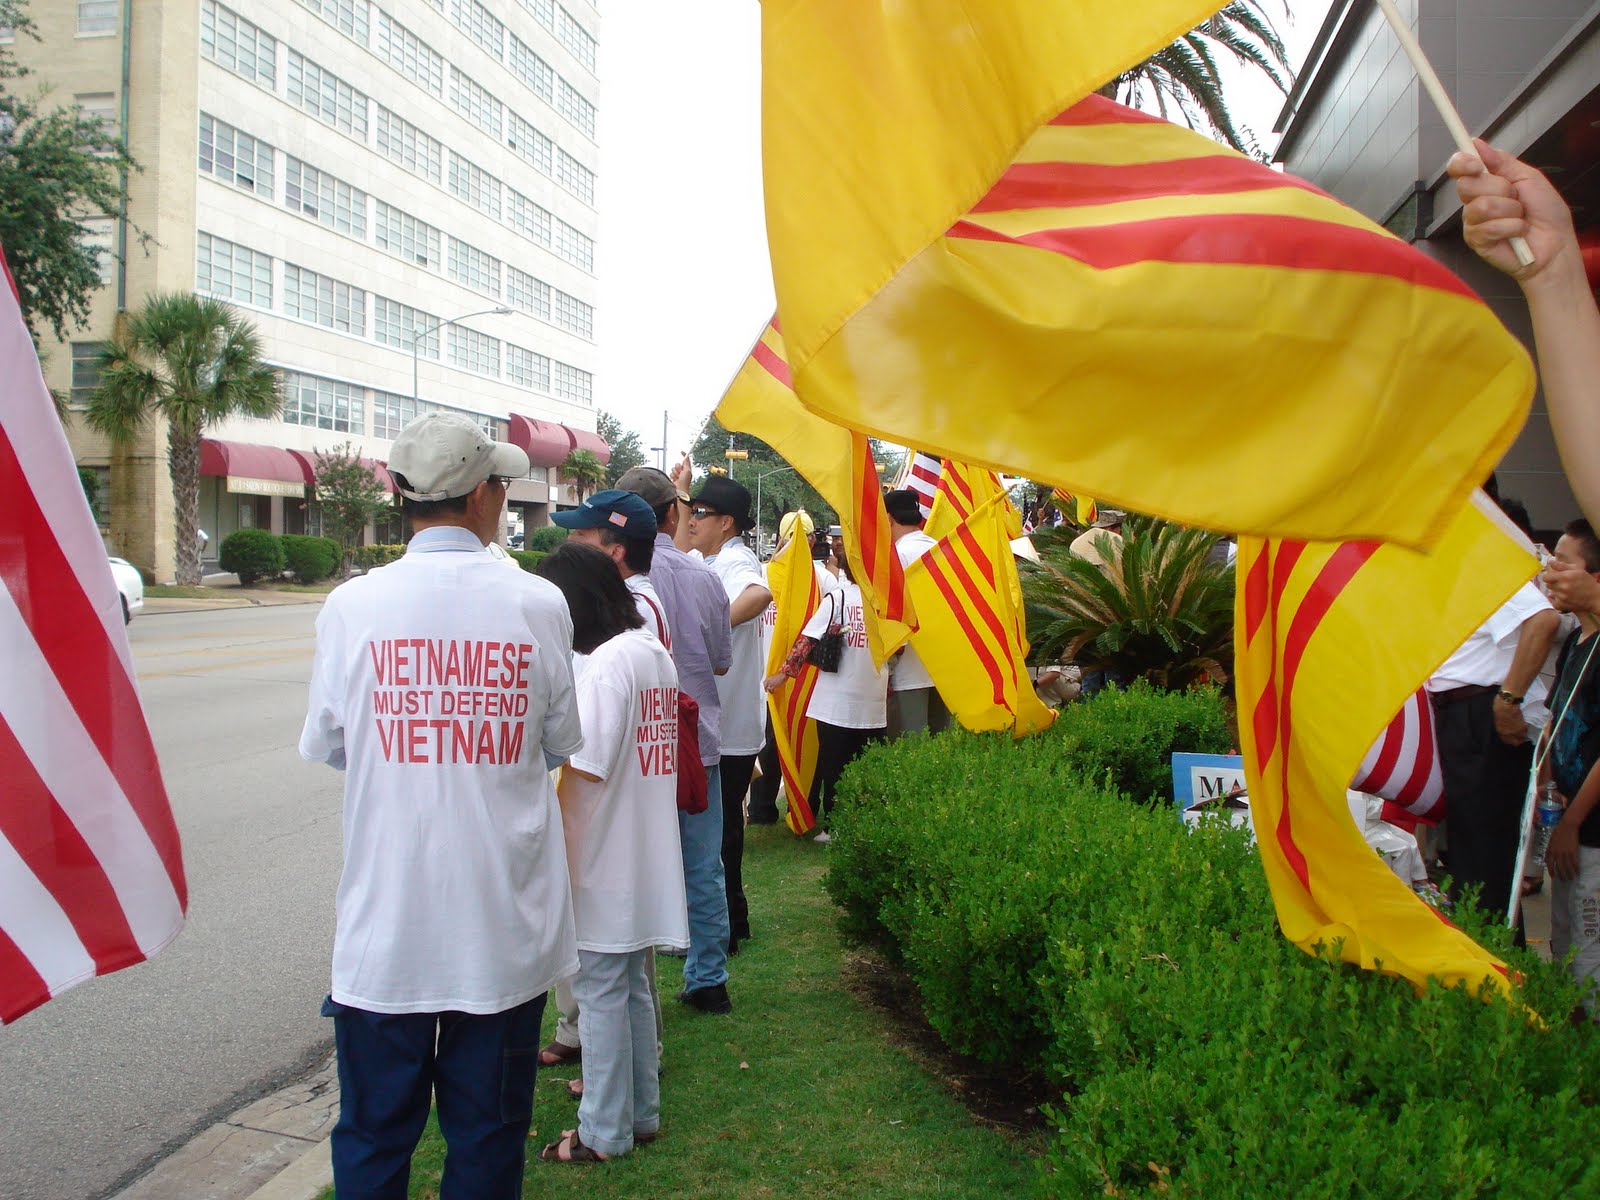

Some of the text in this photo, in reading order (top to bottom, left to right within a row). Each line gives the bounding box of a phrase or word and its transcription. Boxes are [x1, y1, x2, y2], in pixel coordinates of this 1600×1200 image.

[370, 638, 533, 689] VIETNAMESE
[374, 690, 529, 717] MUST DEFEND
[376, 719, 525, 764] VIETNAM
